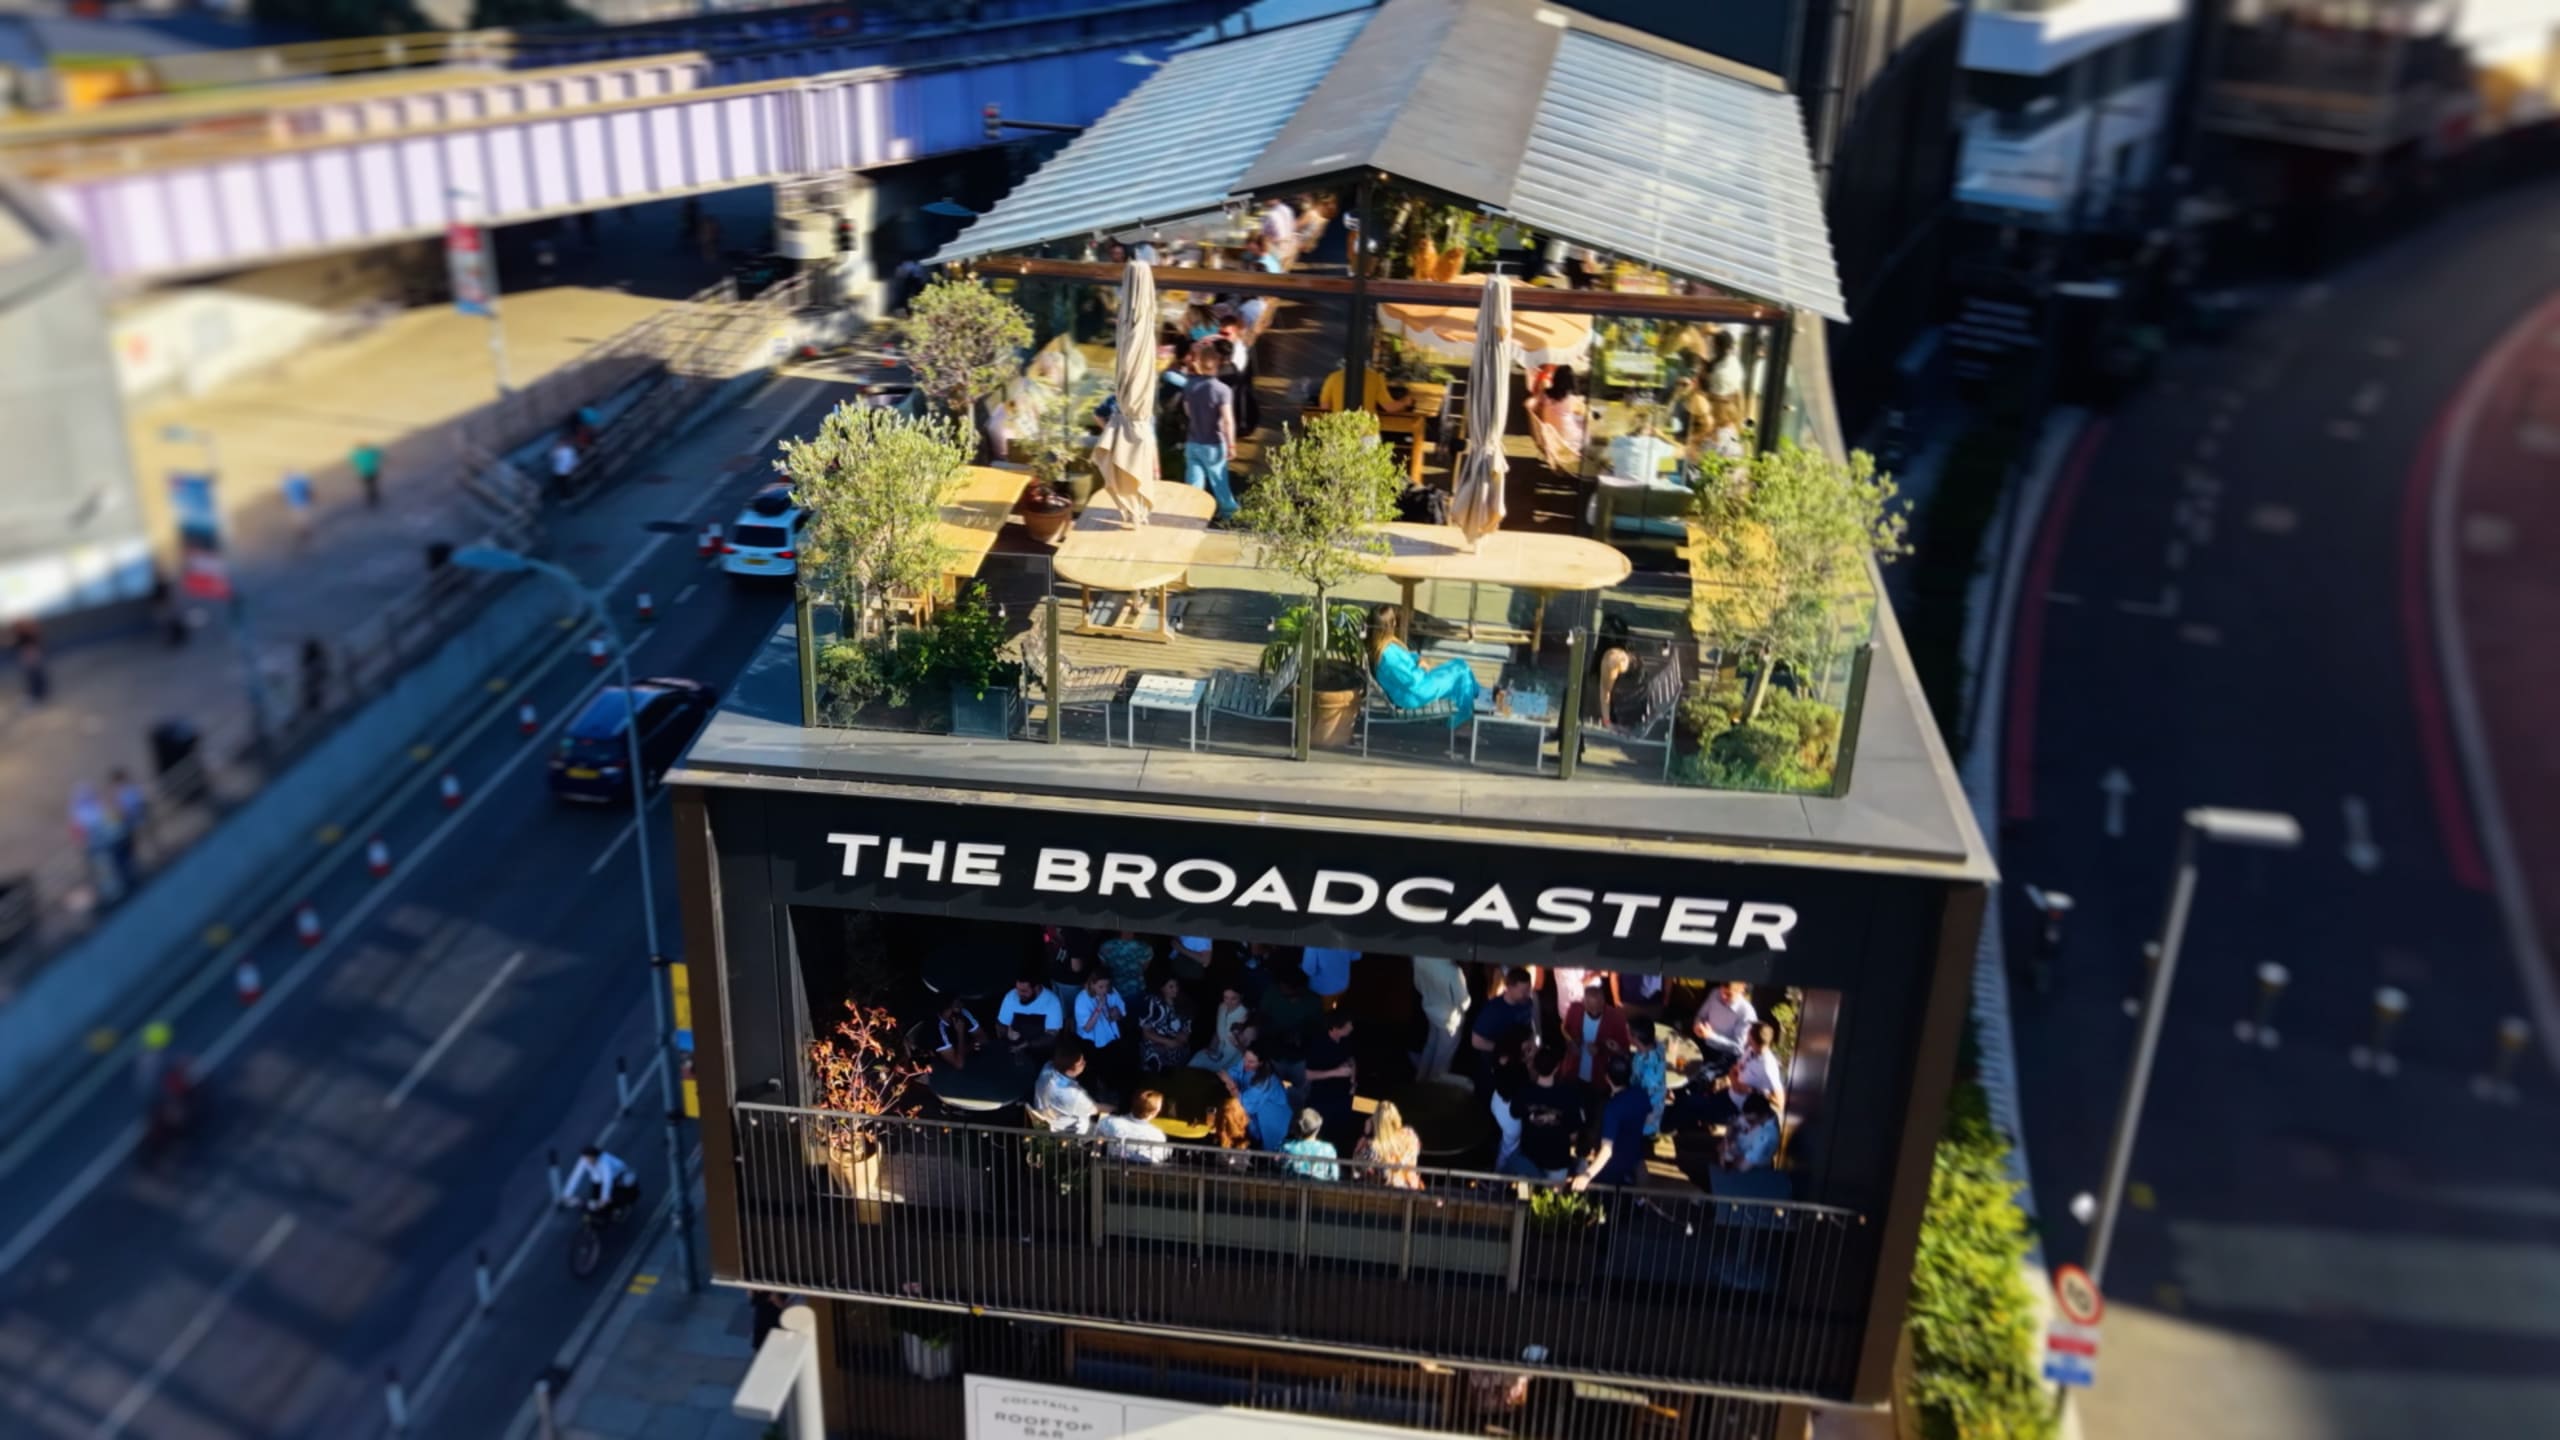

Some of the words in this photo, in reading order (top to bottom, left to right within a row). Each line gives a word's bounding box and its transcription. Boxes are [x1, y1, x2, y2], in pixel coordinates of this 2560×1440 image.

[827, 832, 1007, 887] THE
[1033, 847, 1799, 951] BROADCASTER
[1001, 1396, 1080, 1413] COCKTAILS
[994, 1411, 1094, 1431] ROOFTOP
[1023, 1427, 1064, 1439] BAR
